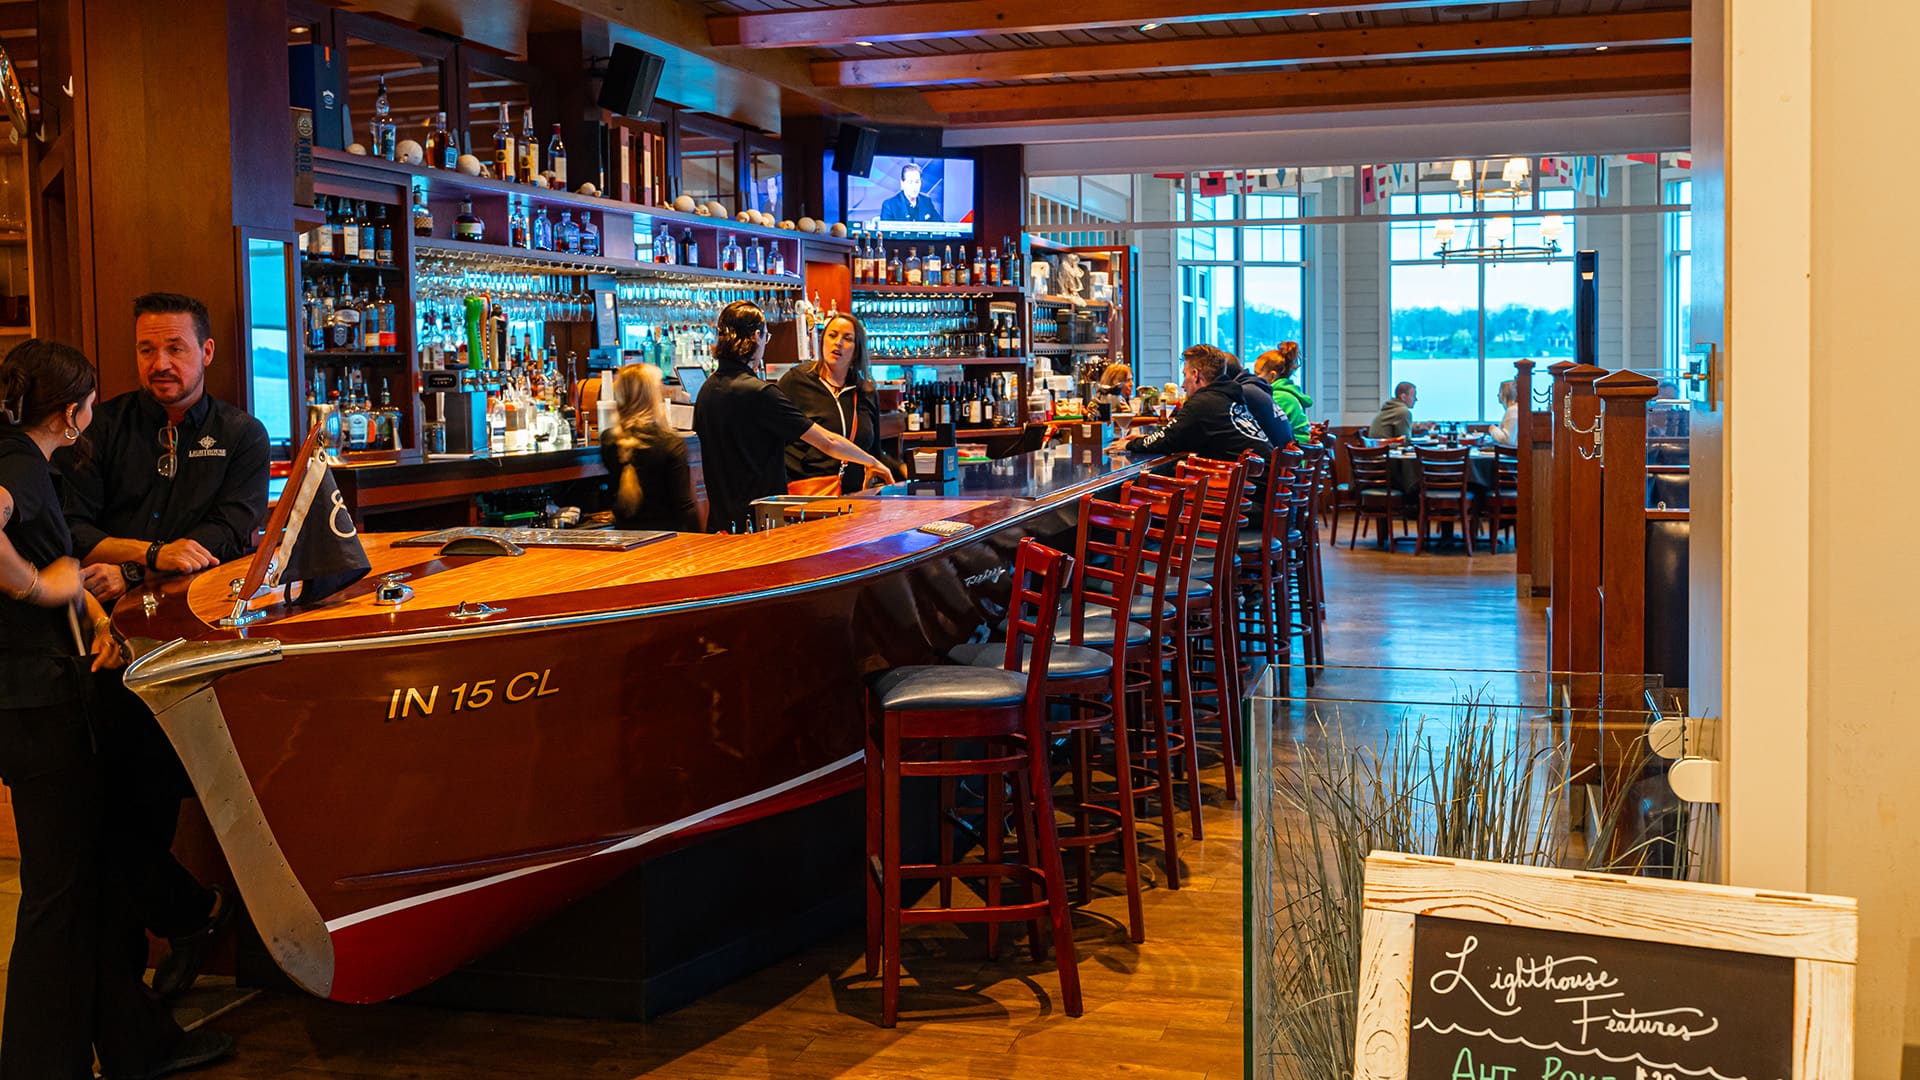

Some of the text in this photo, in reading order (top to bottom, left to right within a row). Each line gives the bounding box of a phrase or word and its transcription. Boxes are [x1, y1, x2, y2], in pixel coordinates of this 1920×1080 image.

[385, 667, 560, 721] IN 15 CL
[1430, 935, 1619, 1016] Lighthouse
[1555, 992, 1719, 1045] Features
